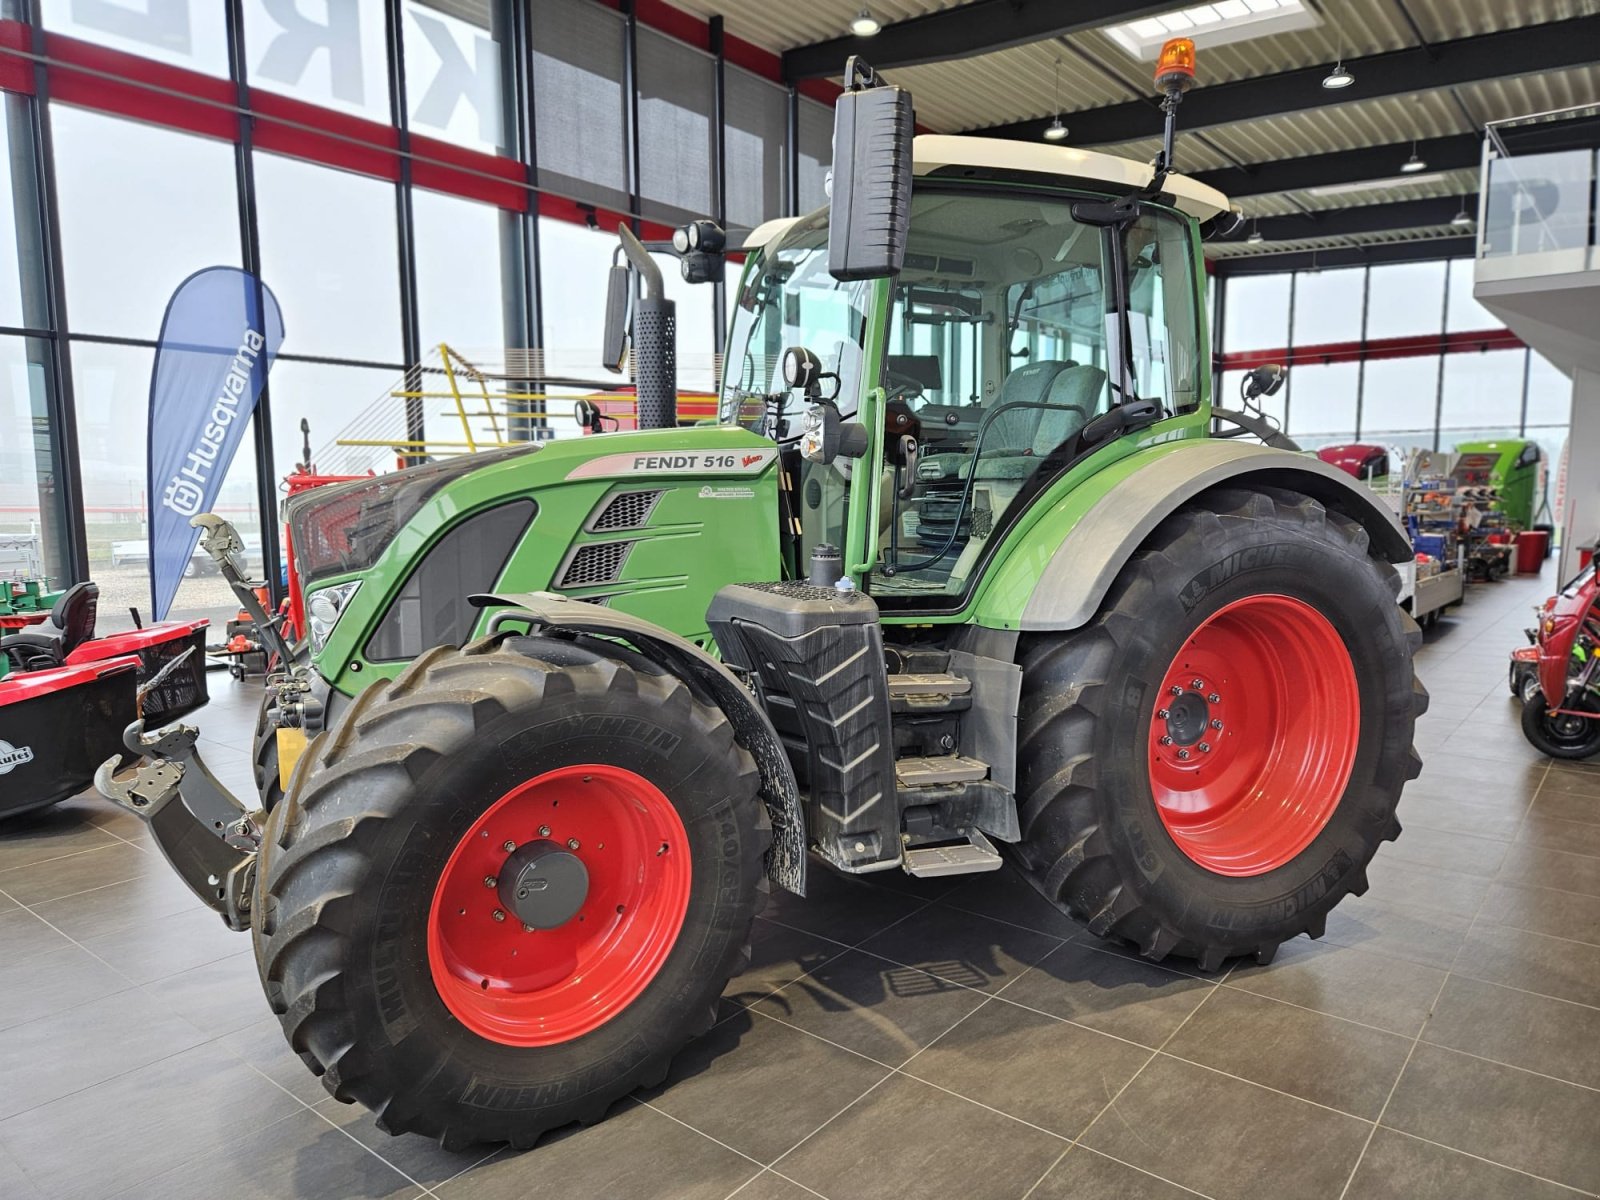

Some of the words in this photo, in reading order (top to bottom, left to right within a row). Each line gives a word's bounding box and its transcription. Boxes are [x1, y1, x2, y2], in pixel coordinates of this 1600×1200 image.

[181, 329, 264, 483] Husqvarna
[633, 455, 699, 470] FENDT
[703, 455, 735, 468] 516
